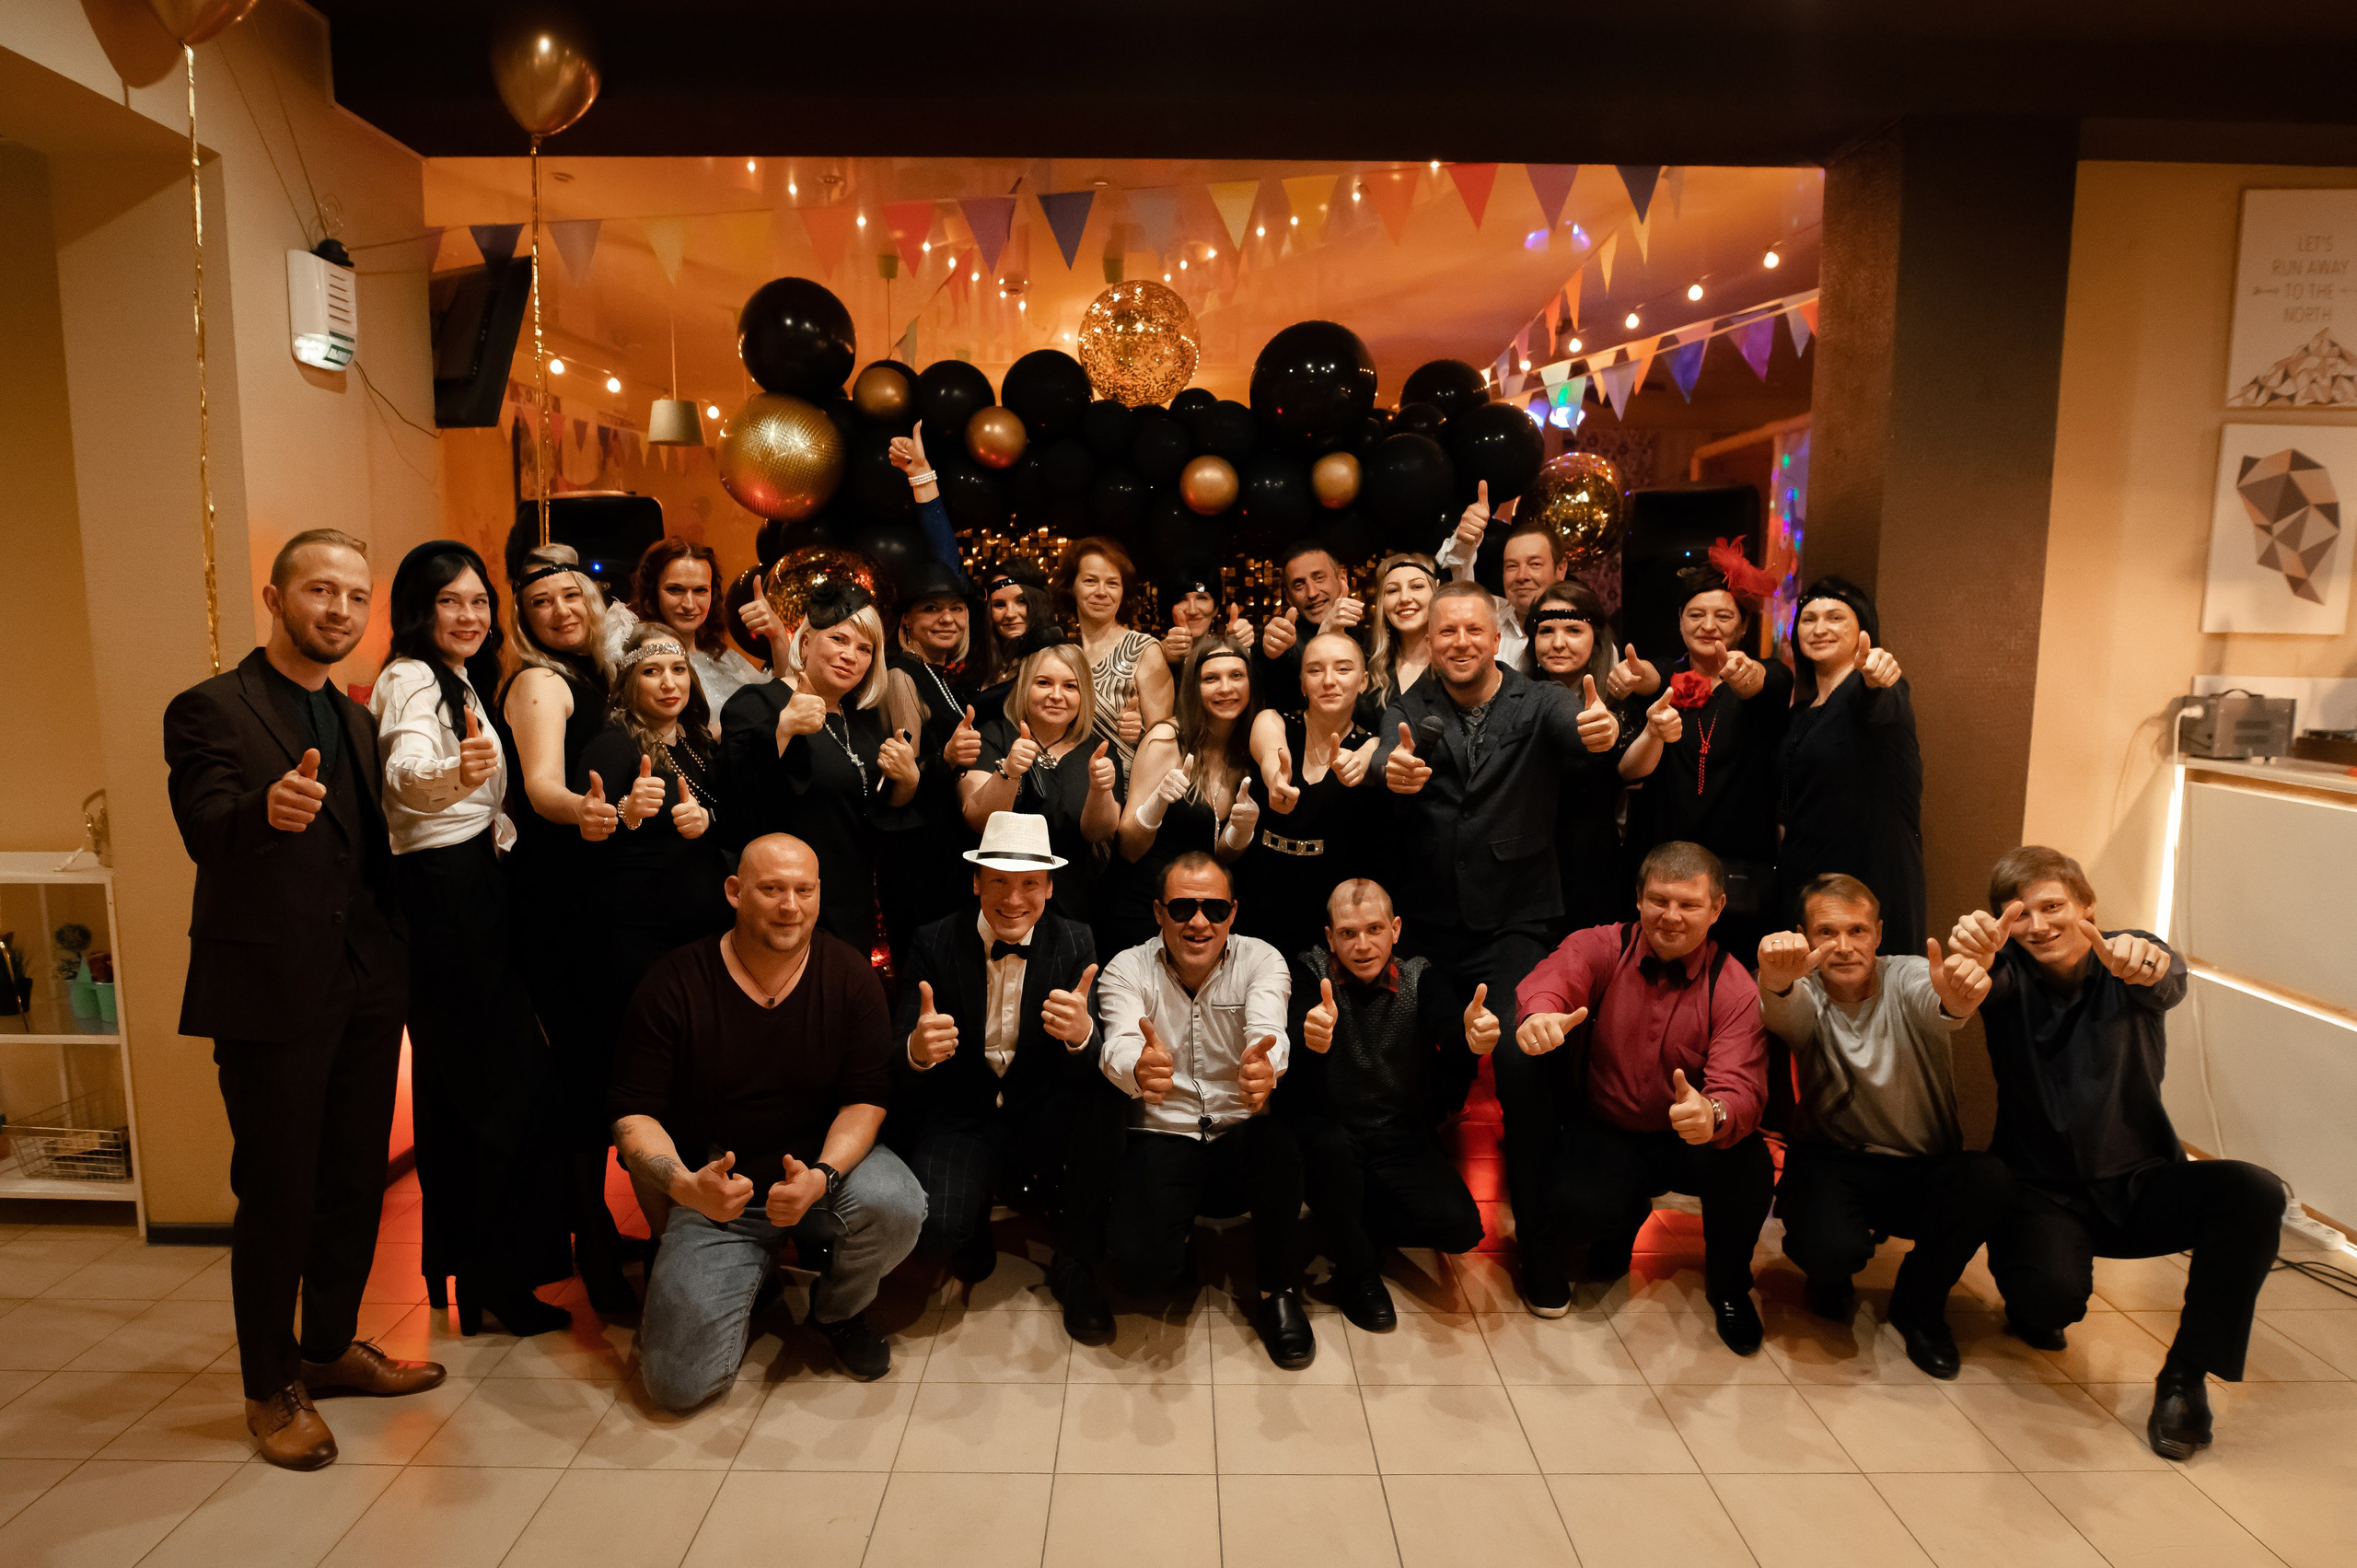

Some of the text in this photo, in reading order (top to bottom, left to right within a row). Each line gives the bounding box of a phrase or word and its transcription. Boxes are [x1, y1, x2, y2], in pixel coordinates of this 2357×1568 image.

[2271, 259, 2350, 276] RUN AWAY
[2284, 283, 2335, 300] TO THE
[2283, 306, 2333, 323] NORTH
